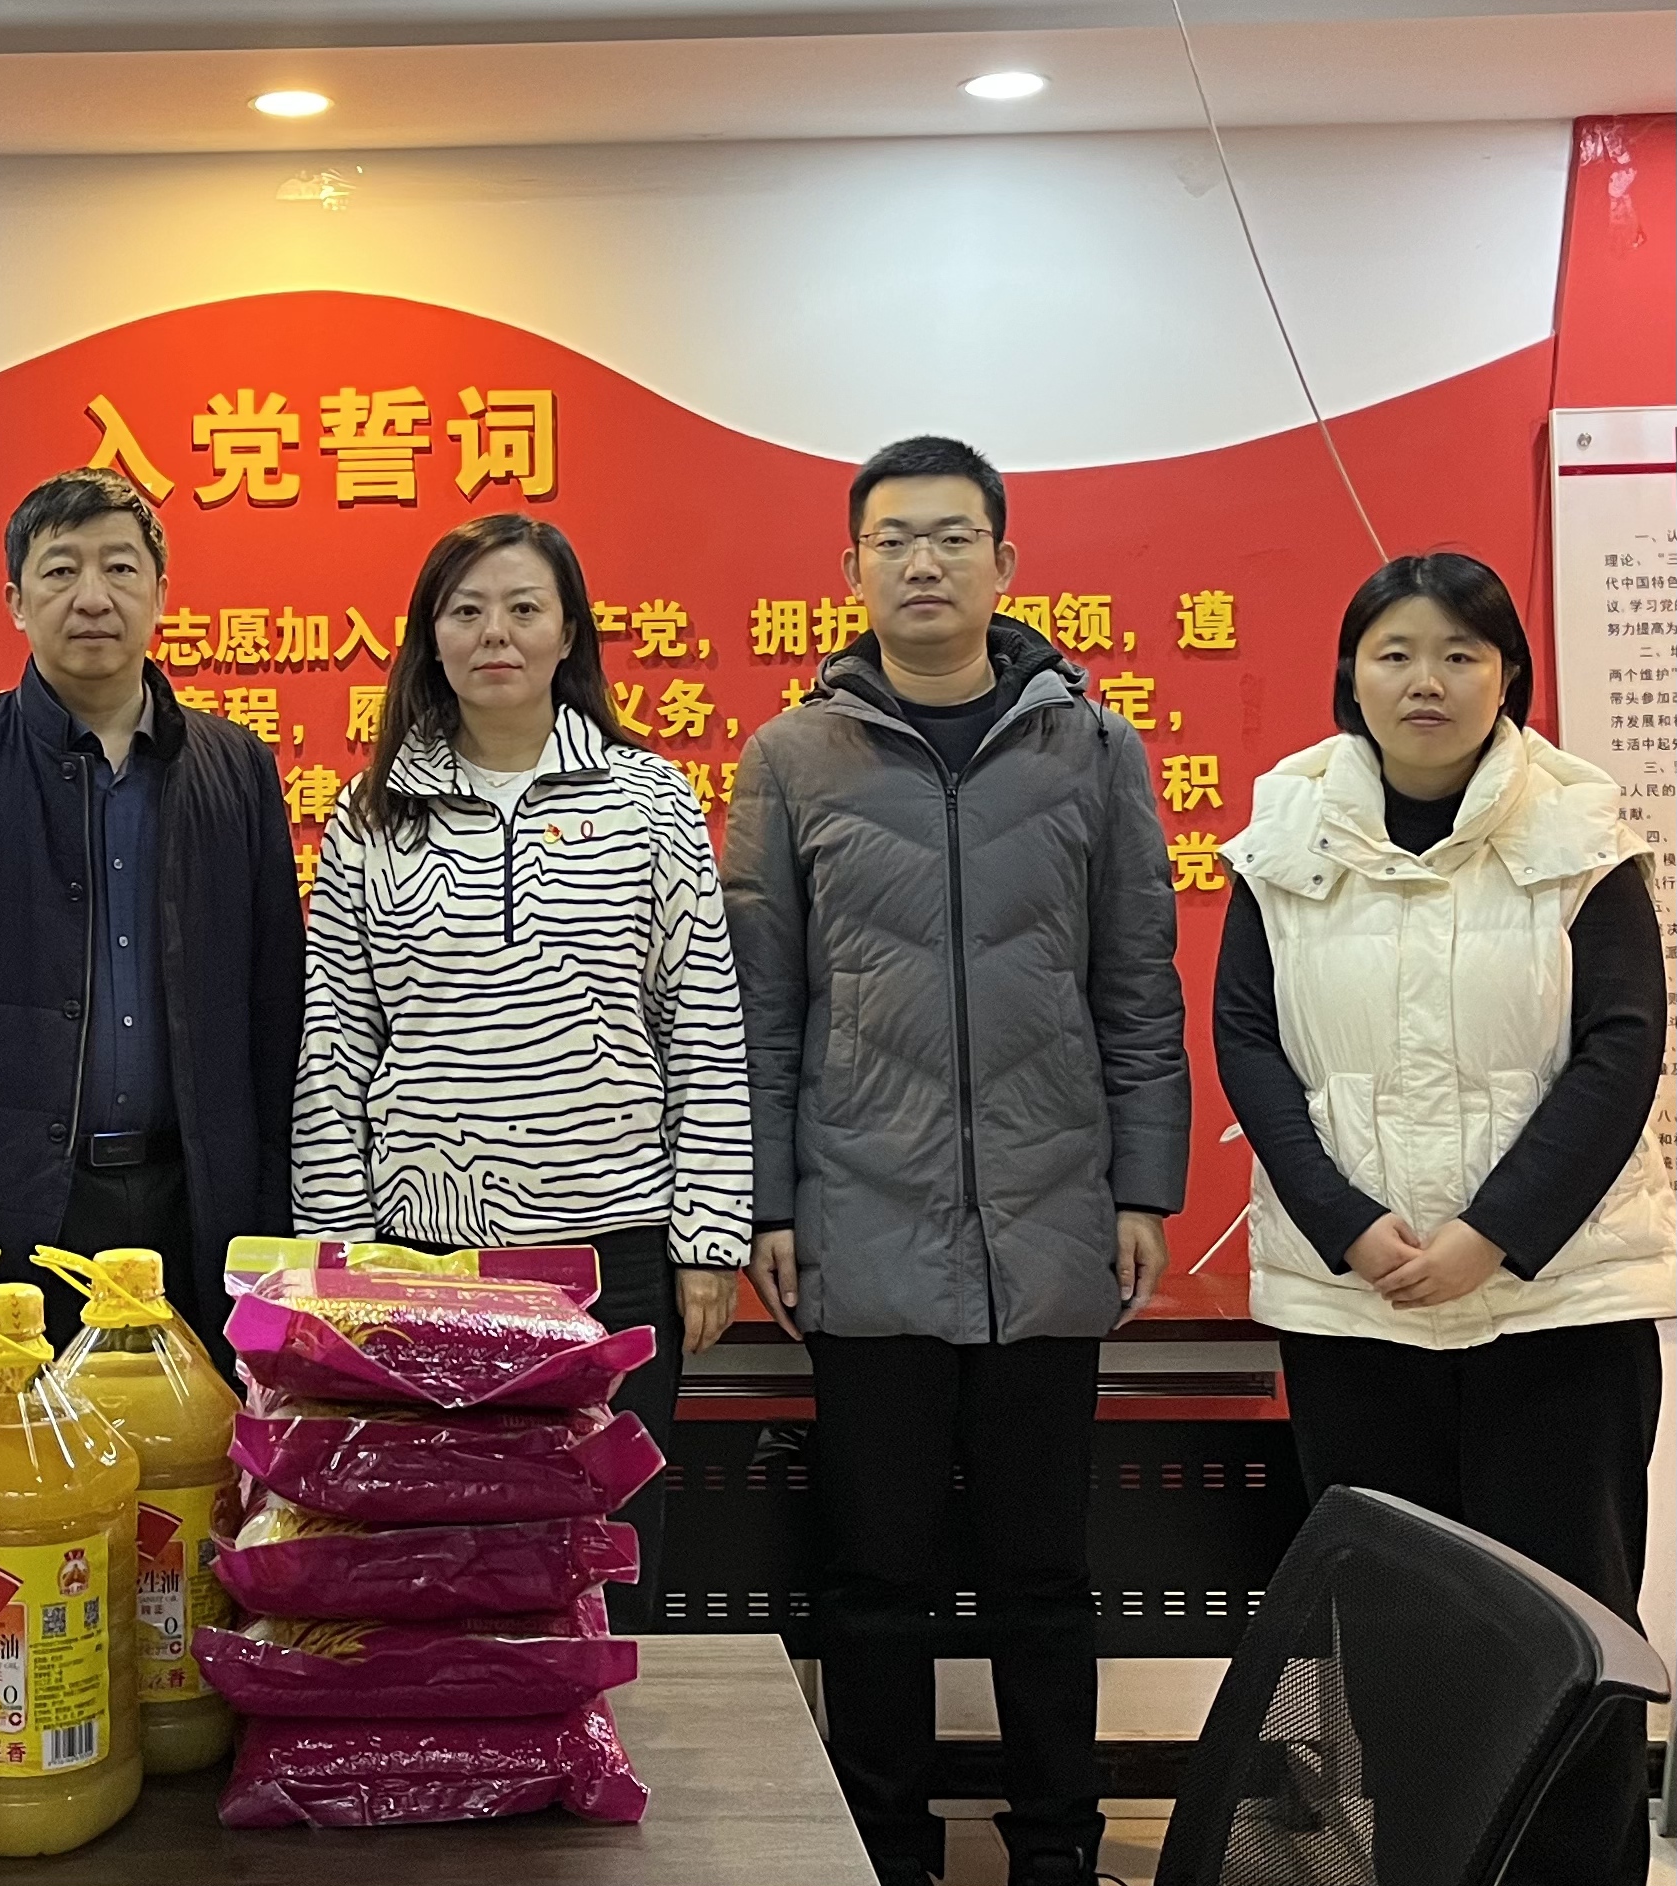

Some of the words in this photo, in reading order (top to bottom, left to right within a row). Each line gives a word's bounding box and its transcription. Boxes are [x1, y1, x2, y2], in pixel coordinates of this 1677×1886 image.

[84, 386, 557, 507] 入党誓词
[144, 605, 408, 667] 志愿加入
[1611, 714, 1677, 728] 济发展和
[1612, 737, 1677, 751] 生活中起
[284, 764, 342, 824] 律
[1162, 754, 1223, 812] 积
[1167, 832, 1225, 892] 党
